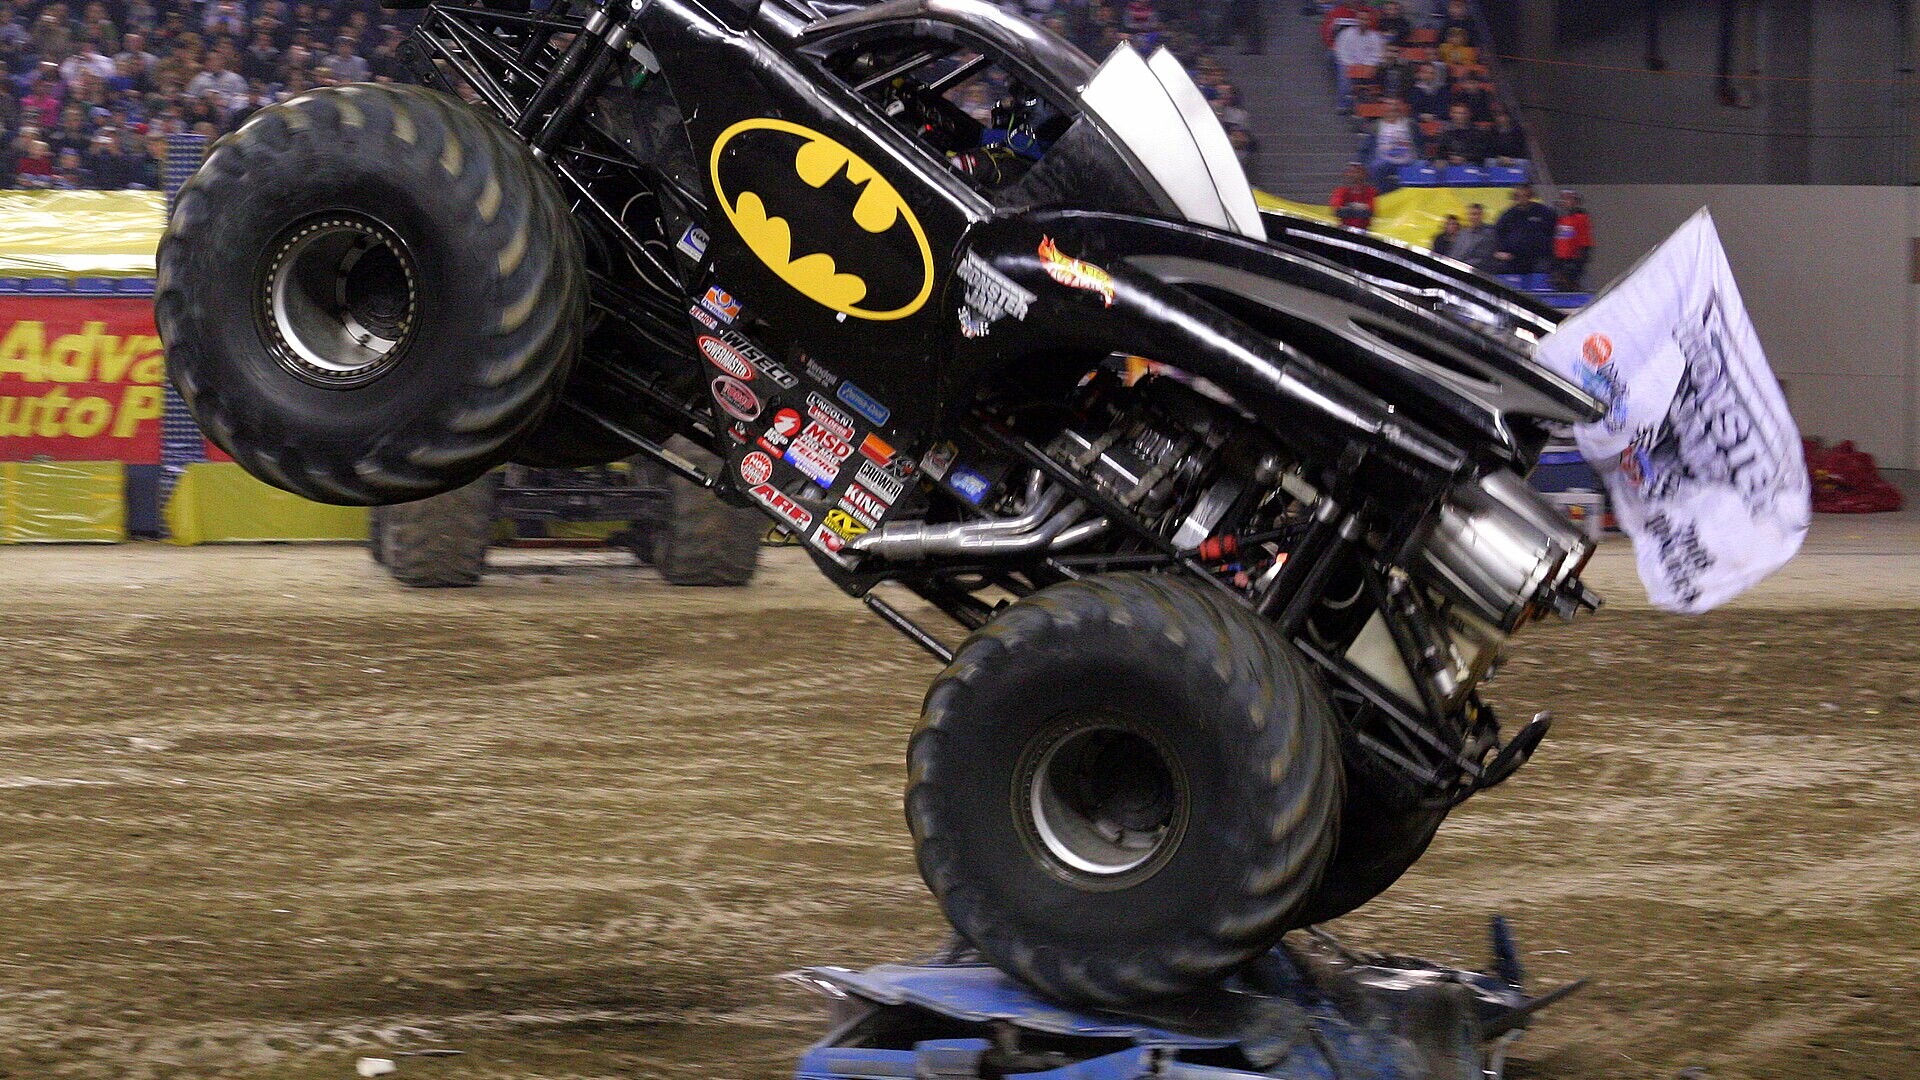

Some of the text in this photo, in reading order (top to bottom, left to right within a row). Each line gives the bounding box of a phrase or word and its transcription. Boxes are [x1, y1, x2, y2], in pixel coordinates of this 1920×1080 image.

[957, 258, 1029, 322] MONSTER
[0, 320, 166, 383] Adva
[703, 339, 748, 378] POWERMASTER
[721, 330, 799, 390] WISECO
[810, 394, 852, 429] LINCOLN
[813, 407, 849, 437] WELDERS
[806, 424, 850, 457] MSD
[860, 463, 901, 498] CROWER
[753, 483, 811, 526] ARP
[844, 484, 886, 521] KING
